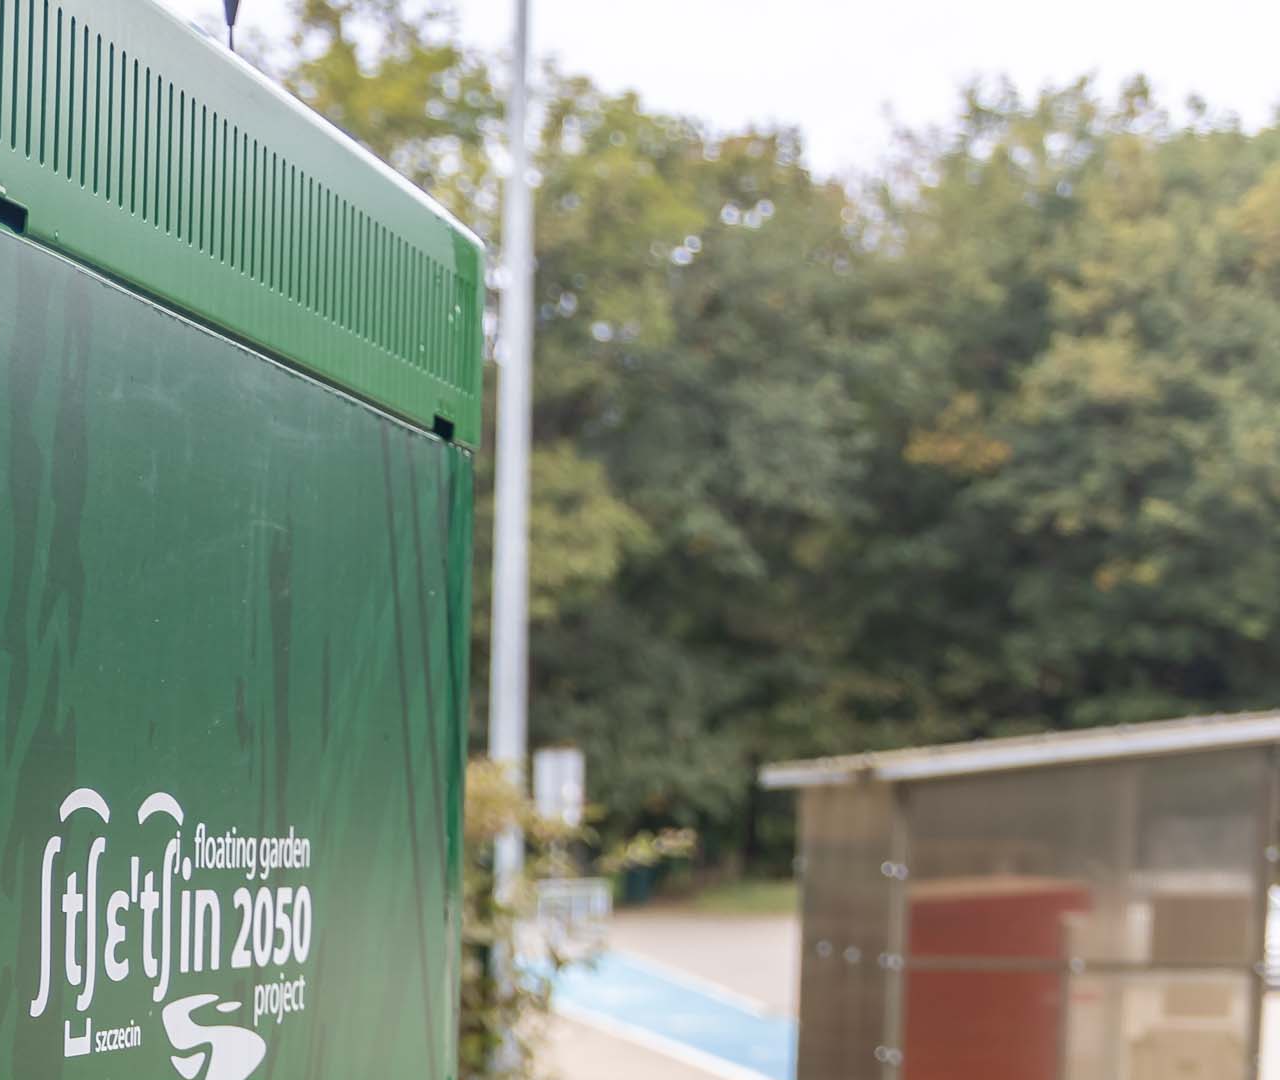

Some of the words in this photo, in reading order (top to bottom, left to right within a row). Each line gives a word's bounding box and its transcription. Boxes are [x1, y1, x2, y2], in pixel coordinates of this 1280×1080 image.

[195, 823, 256, 880] floating
[260, 826, 310, 880] garden
[231, 885, 312, 969] 2050
[254, 973, 305, 1027] project
[95, 1020, 141, 1053] szczecin
